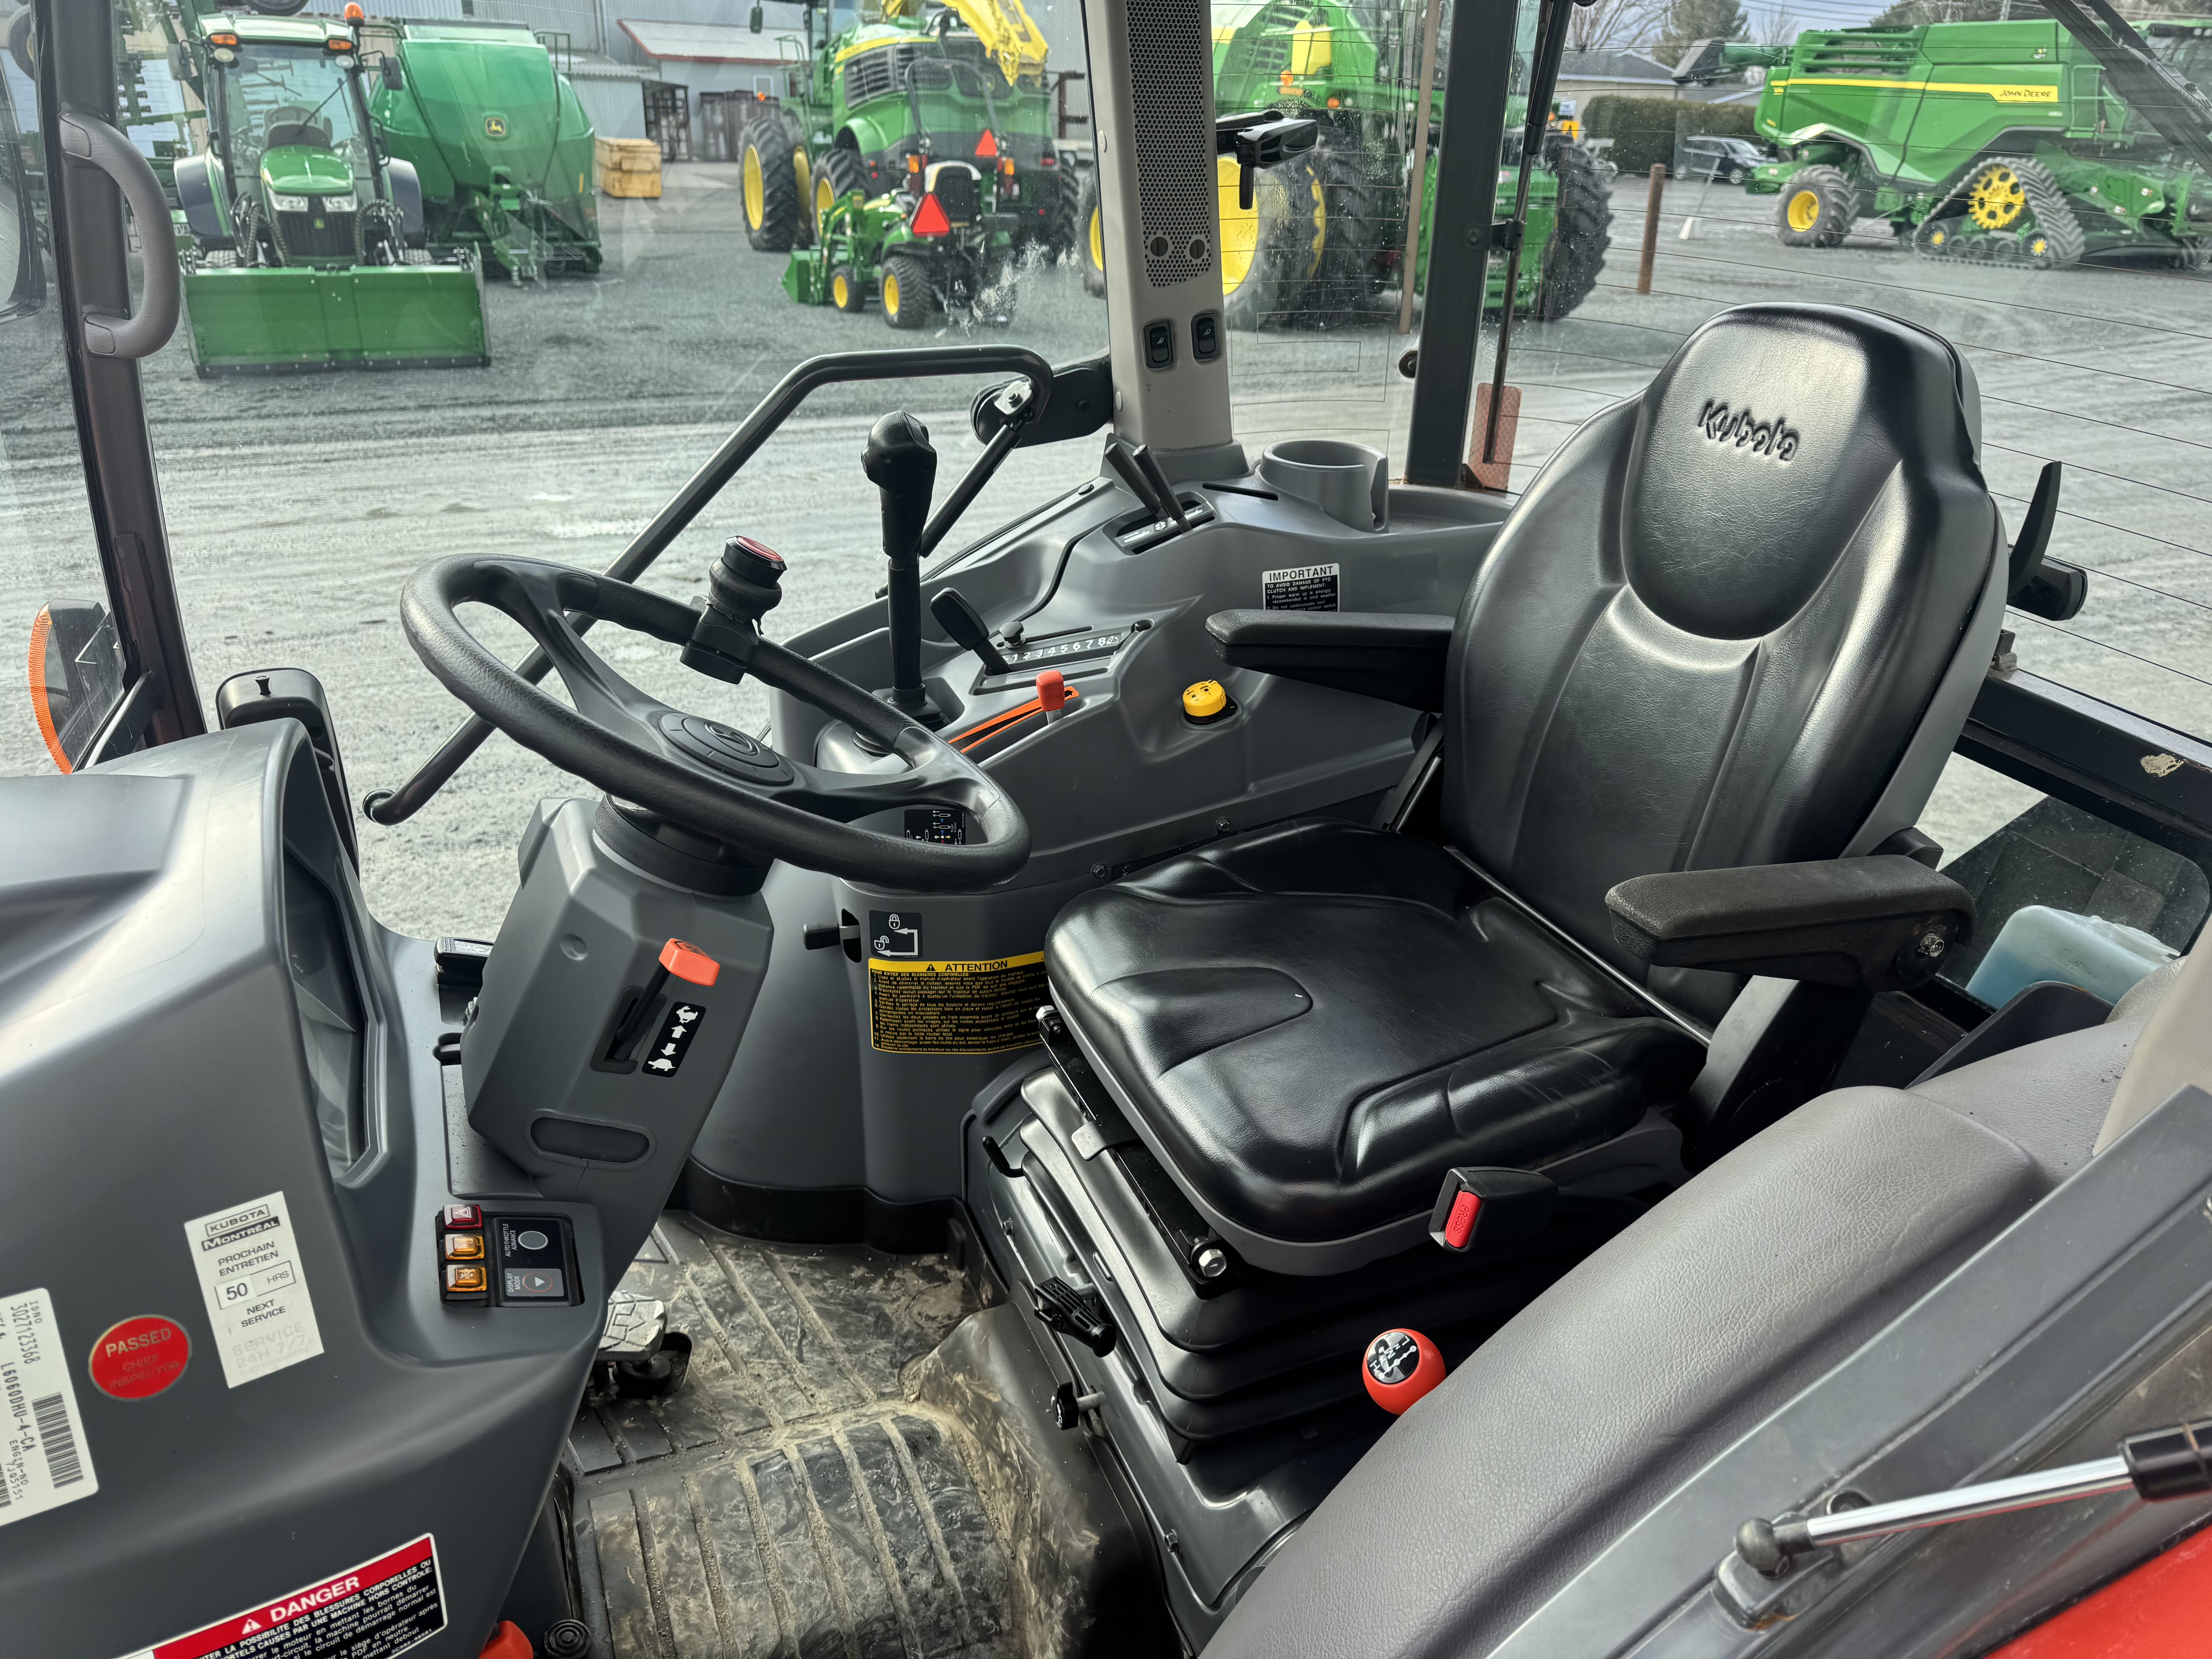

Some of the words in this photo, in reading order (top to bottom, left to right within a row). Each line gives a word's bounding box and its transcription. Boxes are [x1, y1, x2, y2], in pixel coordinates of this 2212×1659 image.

[1698, 401, 1798, 461] Kubota
[1269, 566, 1333, 581] IMPORTANT
[1073, 642, 1080, 650] 6
[1086, 640, 1093, 648] 7
[1098, 637, 1106, 646] 8
[945, 960, 1008, 971] ATTENTION
[210, 1209, 265, 1232] KUBOTA
[1453, 1204, 1471, 1234] PRESS
[218, 1240, 275, 1266] PROCHAIN
[219, 1250, 279, 1276] ENTRETIEN
[226, 1283, 248, 1300] 50
[266, 1271, 289, 1284] HRS
[506, 1273, 514, 1292] DISPLAY
[29, 1301, 43, 1324] IDNO
[241, 1306, 286, 1327] SERVICE
[246, 1299, 275, 1315] NEXT
[10, 1303, 41, 1364] 3027123368
[106, 1328, 171, 1357] PASSED
[232, 1321, 304, 1356] SERVICE
[1402, 1336, 1410, 1346] L
[123, 1353, 159, 1372] CHIEF
[1370, 1360, 1381, 1372] H
[1384, 1346, 1396, 1359] M
[108, 1361, 179, 1389] INSPECTOR
[9, 1439, 29, 1485] ENGIN-NO
[224, 1645, 236, 1654] LA
[239, 1623, 290, 1648] POSSIBILITE
[293, 1615, 310, 1626] DES
[314, 1594, 360, 1618] BLESSURES
[363, 1566, 417, 1596] CORPORELLES
[420, 1559, 431, 1569] OU
[258, 1631, 291, 1649] CAUSES
[293, 1624, 309, 1635] PAR
[311, 1616, 328, 1627] UNE
[330, 1599, 366, 1619] MACHINE
[368, 1589, 390, 1602] HORS
[392, 1567, 433, 1591] CONTROLE:
[270, 1576, 360, 1623] DANGER
[326, 1621, 359, 1639] machine
[362, 1604, 393, 1624] pourrait
[396, 1584, 429, 1606] démarrer
[283, 1633, 312, 1649] moteur
[330, 1612, 360, 1630] mettant
[363, 1606, 374, 1614] les
[378, 1592, 404, 1608] bornes
[407, 1584, 417, 1593] du
[316, 1636, 341, 1652] circuit
[343, 1631, 353, 1639] de
[356, 1609, 396, 1633] démarrage
[398, 1595, 423, 1612] normal
[426, 1589, 436, 1598] est
[340, 1648, 348, 1656] le
[351, 1638, 371, 1651] siège
[374, 1613, 416, 1640] d'opérateur
[419, 1602, 438, 1616] après
[351, 1646, 368, 1659] PDF
[372, 1640, 381, 1649] en
[385, 1627, 410, 1642] neutre.
[363, 1642, 391, 1659] mettant
[394, 1626, 420, 1644] debout
